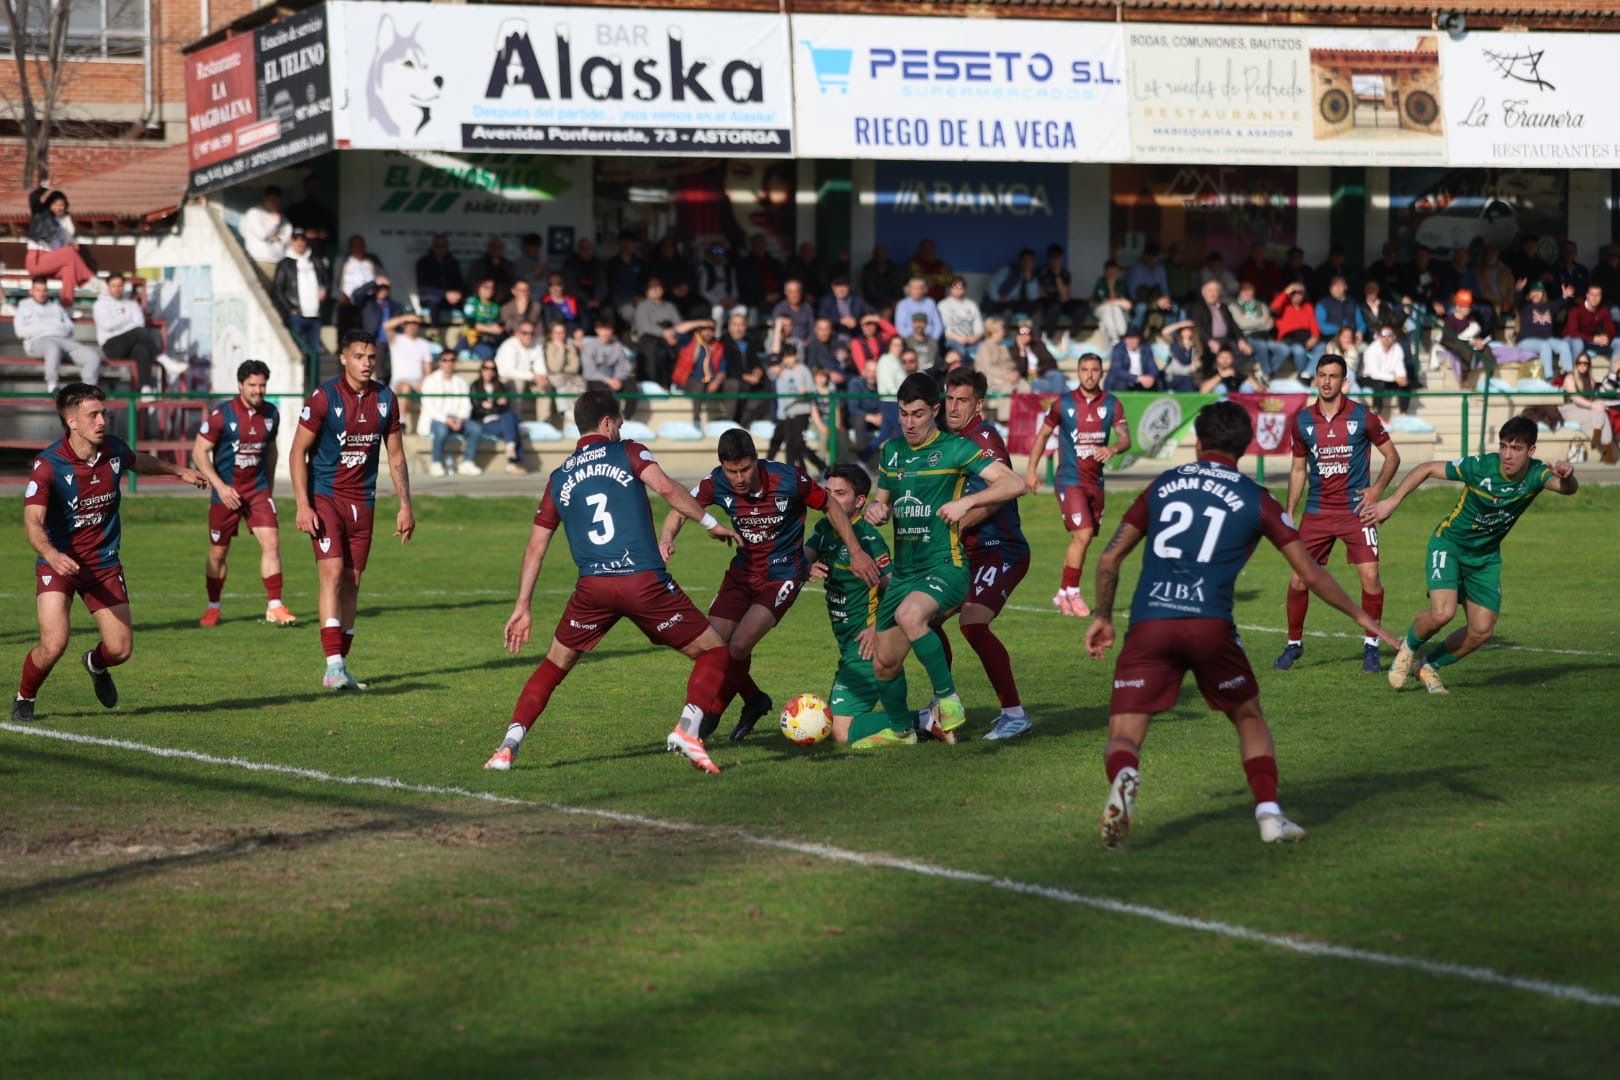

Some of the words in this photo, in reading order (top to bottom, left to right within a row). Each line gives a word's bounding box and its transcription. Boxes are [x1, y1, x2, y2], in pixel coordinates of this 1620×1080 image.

[596, 24, 649, 46] BAR
[1172, 36, 1246, 49] COMUNIONES,
[1250, 38, 1302, 50] BAUTIZOS
[264, 60, 281, 84] EL
[279, 42, 326, 79] TELENO
[484, 20, 764, 104] Alaska
[869, 48, 1054, 82] PESETO
[1071, 61, 1121, 85] S.L.
[211, 80, 228, 101] LA
[901, 85, 1096, 101] SUPERMERCADOS
[190, 98, 254, 134] MAGDALENA
[1143, 108, 1301, 121] RESTAURANTE
[1457, 96, 1490, 128] La
[472, 126, 545, 142] Avenida
[550, 127, 650, 144] Ponferrada,
[655, 129, 678, 143] 73
[692, 130, 781, 145] ASTORGA
[855, 117, 929, 147] RIEGO
[939, 118, 968, 148] DE
[978, 120, 1006, 149] LA
[1015, 120, 1077, 149] VEGA
[1492, 143, 1611, 159] RESTAURANTES
[384, 165, 412, 188] EL
[559, 475, 578, 507] JOSÉ
[575, 463, 635, 488] MARTINEZ
[1157, 477, 1199, 498] JUAN
[1202, 478, 1245, 513] SILVA
[585, 492, 615, 545] 3
[904, 504, 932, 519] PABLO
[1153, 501, 1227, 563] 21
[1362, 526, 1378, 546] 10
[1432, 550, 1448, 569] 11
[974, 565, 998, 587] 14
[1148, 576, 1205, 602] ZIBÁ
